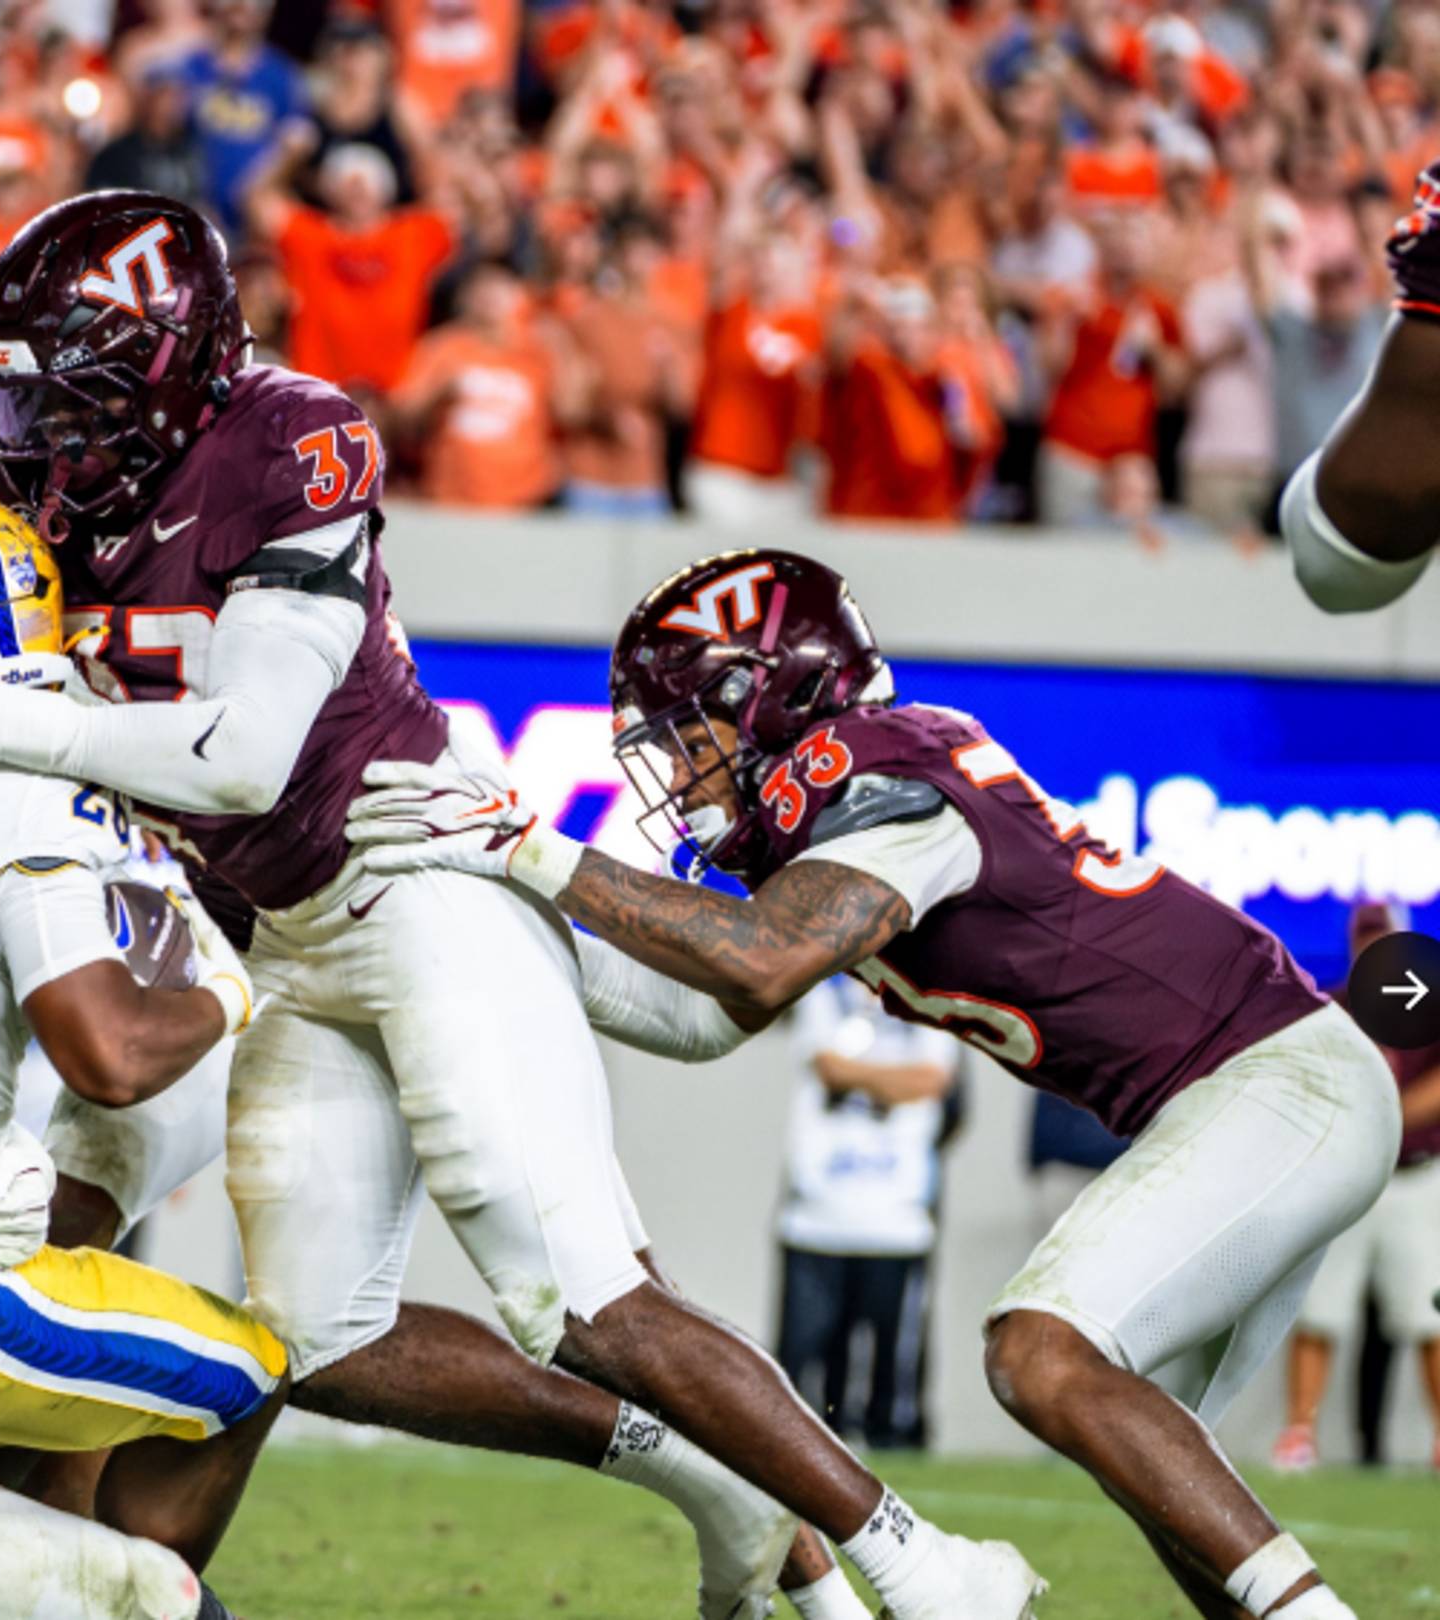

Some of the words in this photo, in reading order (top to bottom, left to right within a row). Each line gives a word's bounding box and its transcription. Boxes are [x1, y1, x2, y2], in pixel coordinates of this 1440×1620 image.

[80, 219, 174, 318] VT
[295, 421, 384, 511] 37
[92, 533, 130, 561] VT
[658, 561, 776, 643] VT
[761, 726, 853, 834] 33
